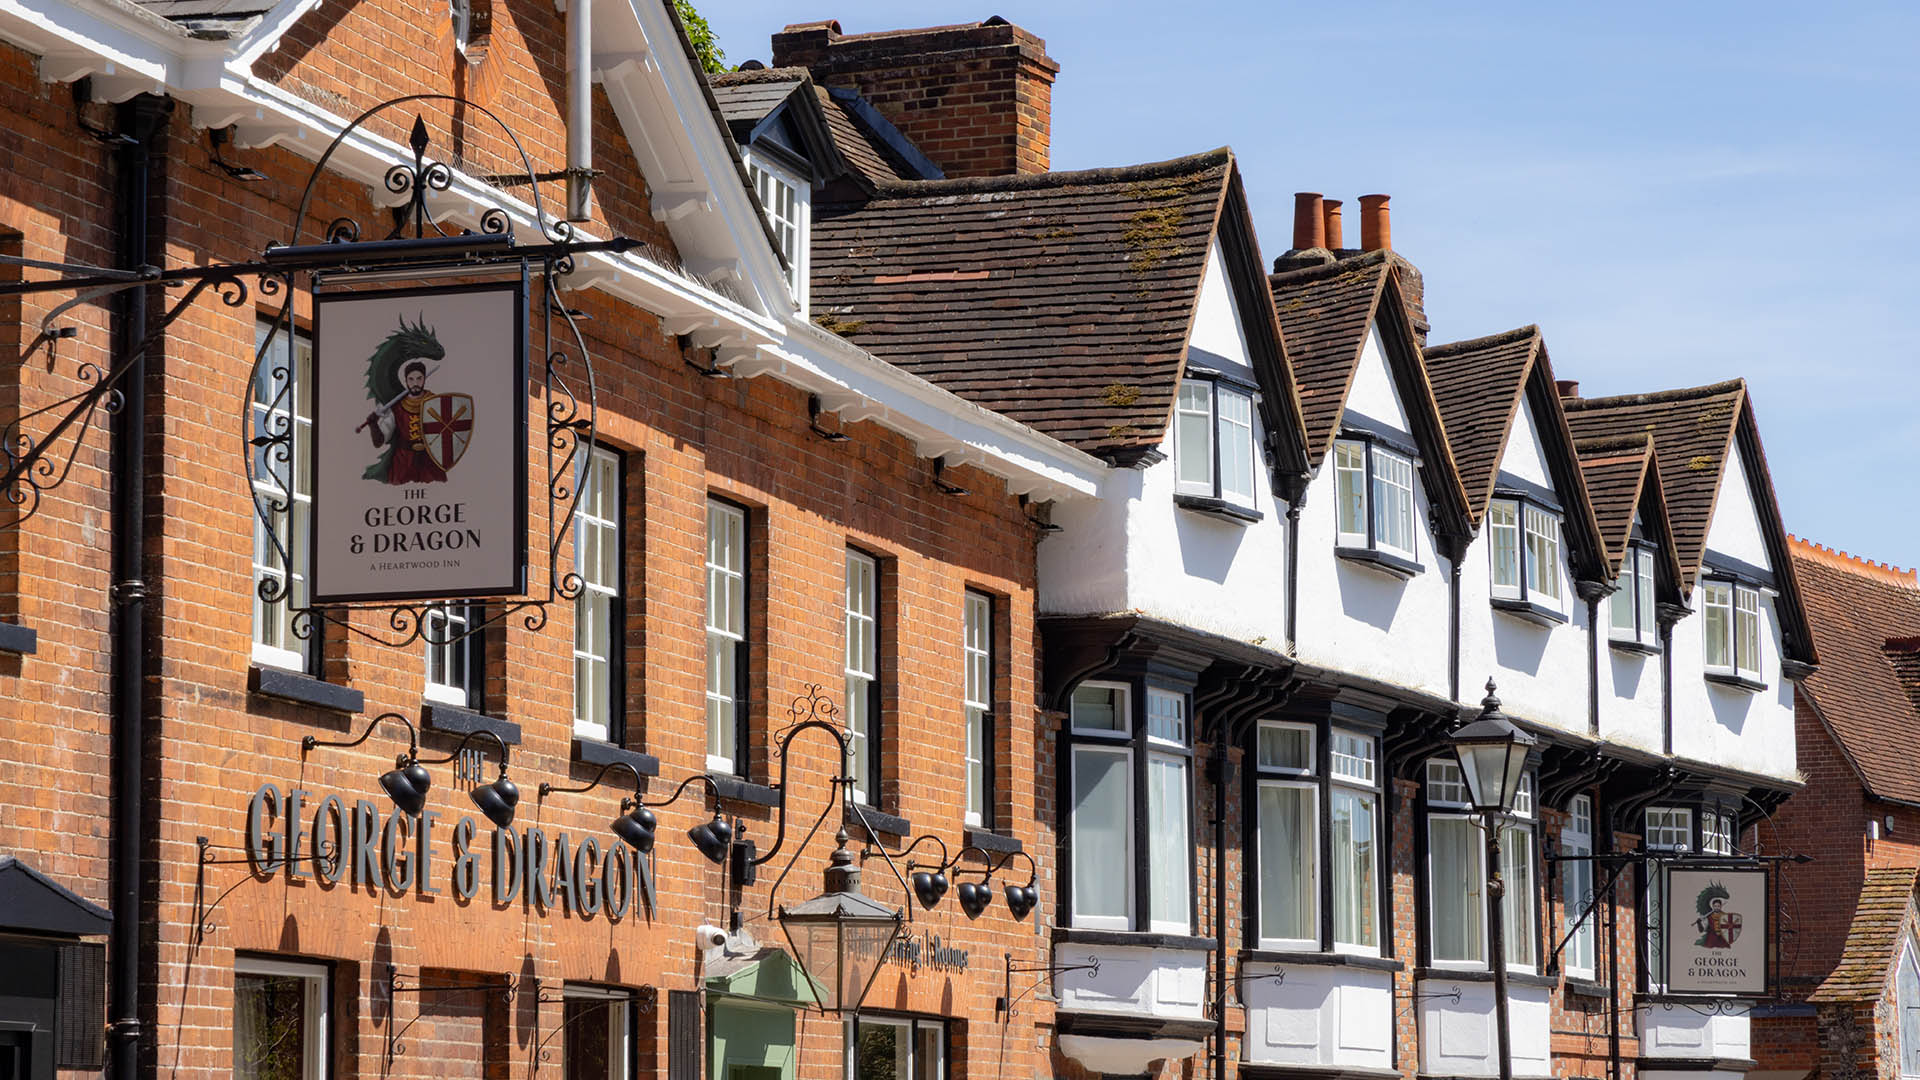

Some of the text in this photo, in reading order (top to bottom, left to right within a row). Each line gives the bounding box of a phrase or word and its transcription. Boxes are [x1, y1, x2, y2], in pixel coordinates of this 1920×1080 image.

[404, 489, 427, 500] THE
[365, 503, 466, 527] GEORGE
[349, 529, 481, 554] & DRAGON
[370, 559, 461, 571] A HEARTWOOD INN
[459, 748, 488, 784] THE
[252, 783, 442, 893] GEORGE
[456, 816, 657, 921] & DRAGON
[1688, 968, 1746, 977] & DRAGON
[1694, 957, 1737, 966] GEORGE
